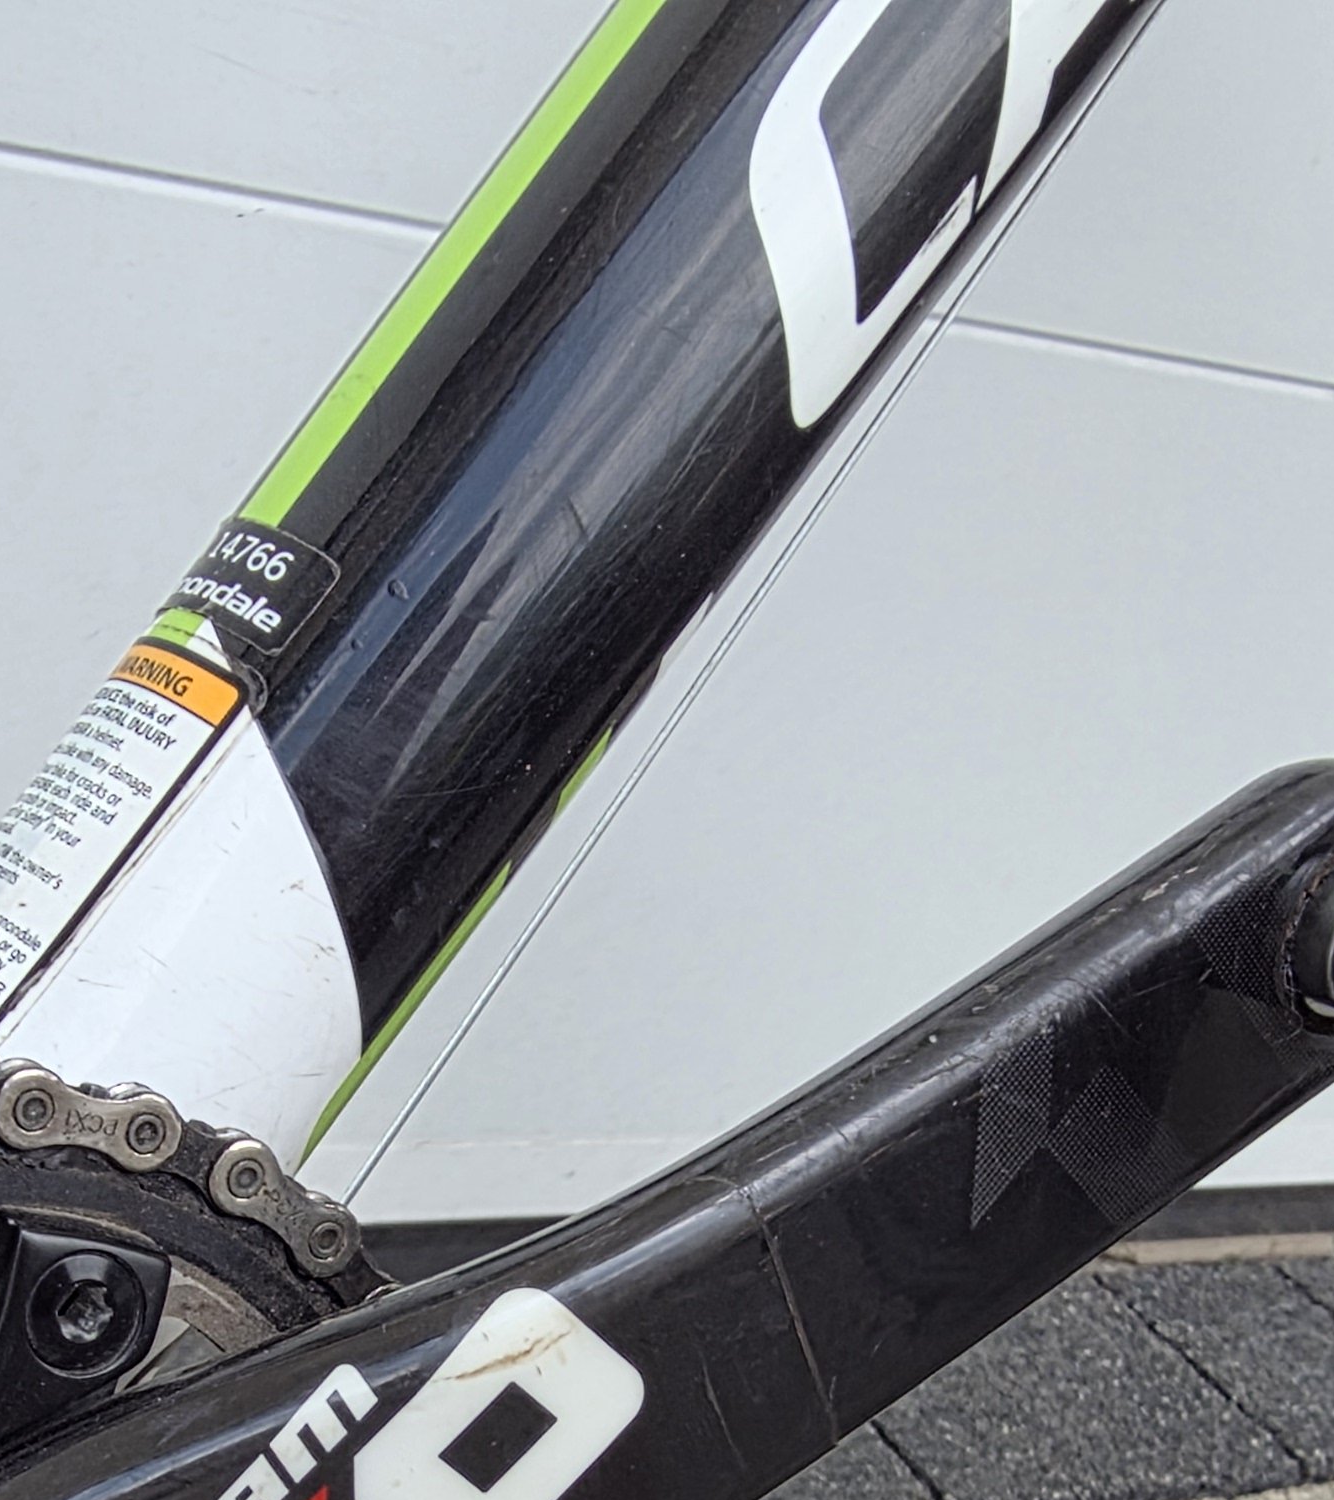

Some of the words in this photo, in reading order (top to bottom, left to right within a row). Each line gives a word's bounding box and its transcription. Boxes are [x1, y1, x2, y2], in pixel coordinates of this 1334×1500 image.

[209, 532, 294, 582] 14766
[133, 698, 159, 718] risk
[155, 709, 176, 726] of
[126, 717, 177, 751] INJURY
[75, 773, 110, 799] cracks
[105, 792, 122, 806] or
[107, 764, 153, 799] damage.
[43, 799, 79, 826] impact.
[68, 791, 94, 811] ride
[89, 802, 118, 825] and
[50, 827, 81, 851] your
[20, 857, 65, 889] owner's
[7, 948, 28, 965] go
